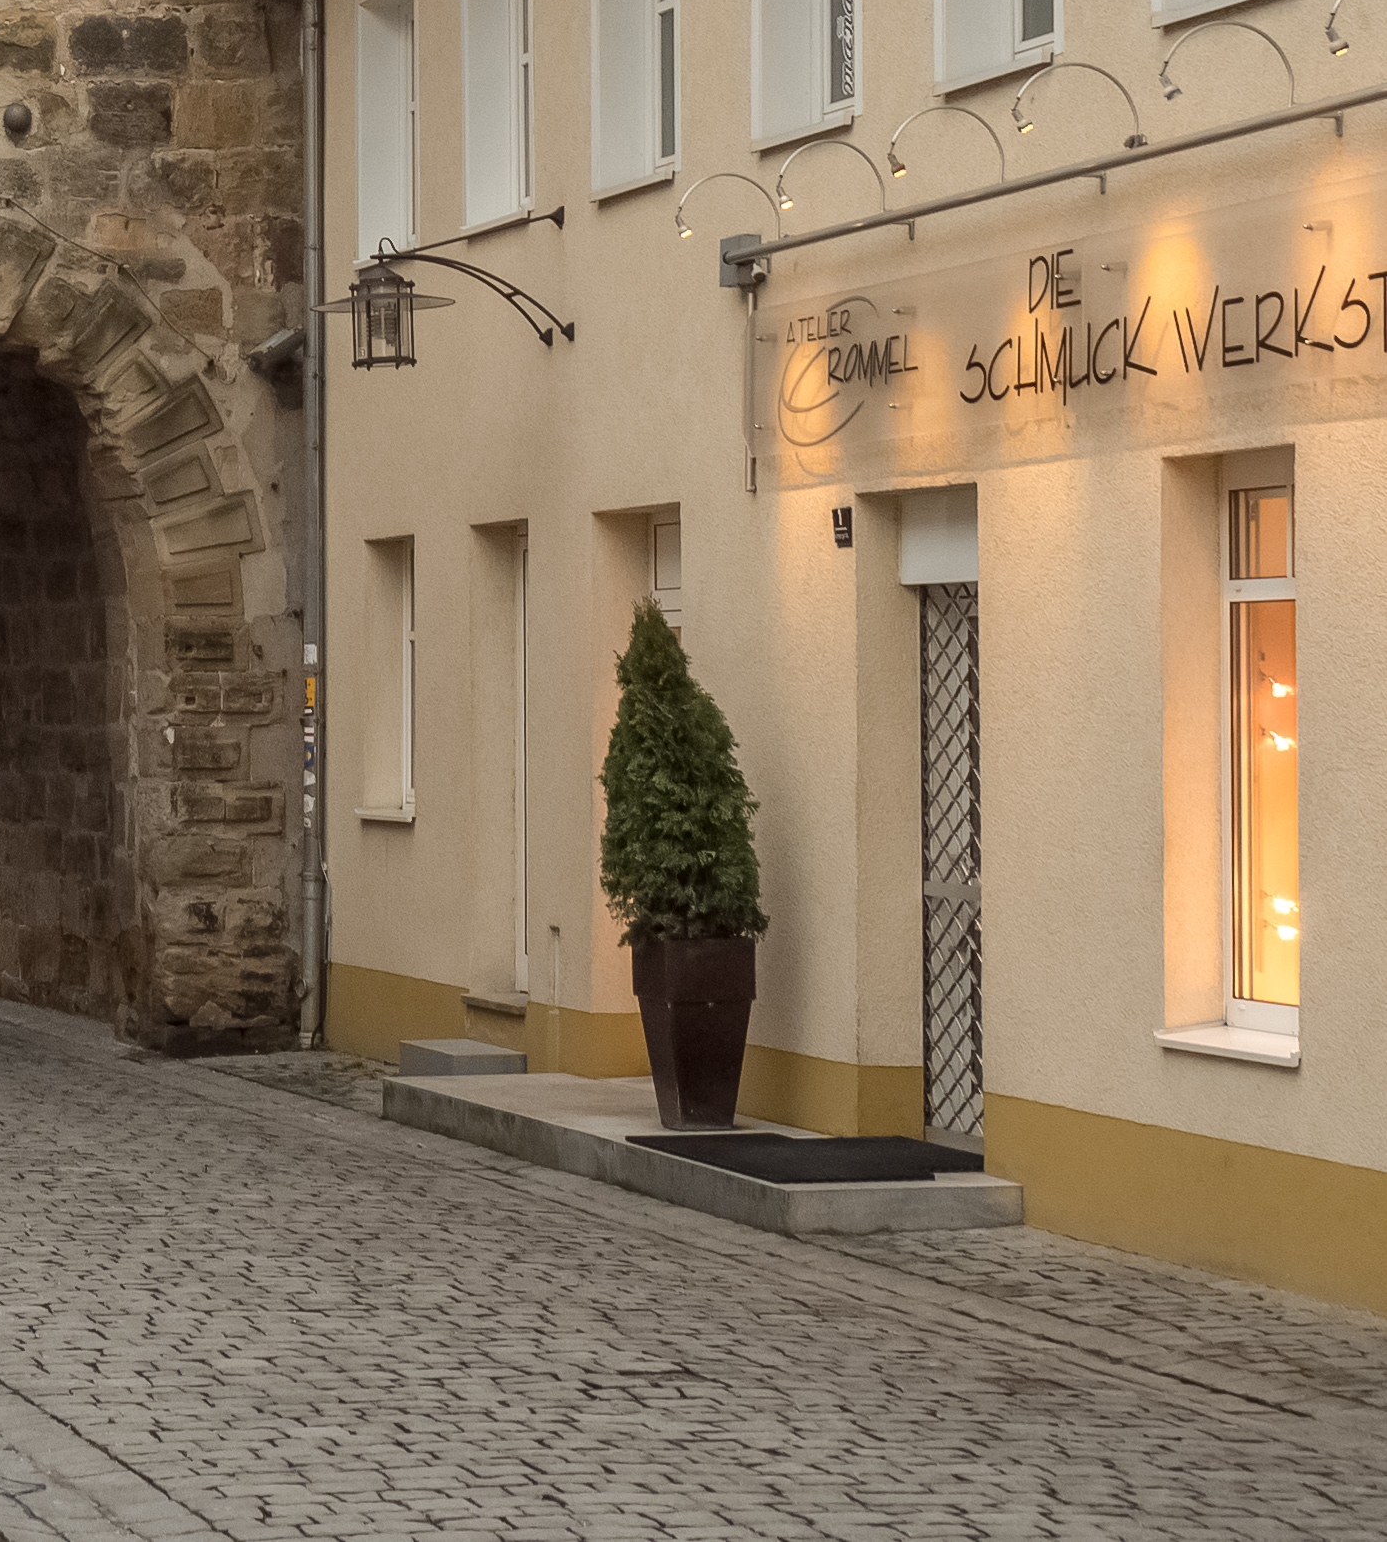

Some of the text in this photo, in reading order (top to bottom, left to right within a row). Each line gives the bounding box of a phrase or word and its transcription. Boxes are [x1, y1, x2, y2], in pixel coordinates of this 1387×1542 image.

[1028, 248, 1082, 314] DIE
[786, 309, 853, 345] ATELIER
[826, 334, 919, 388] ROMMEL
